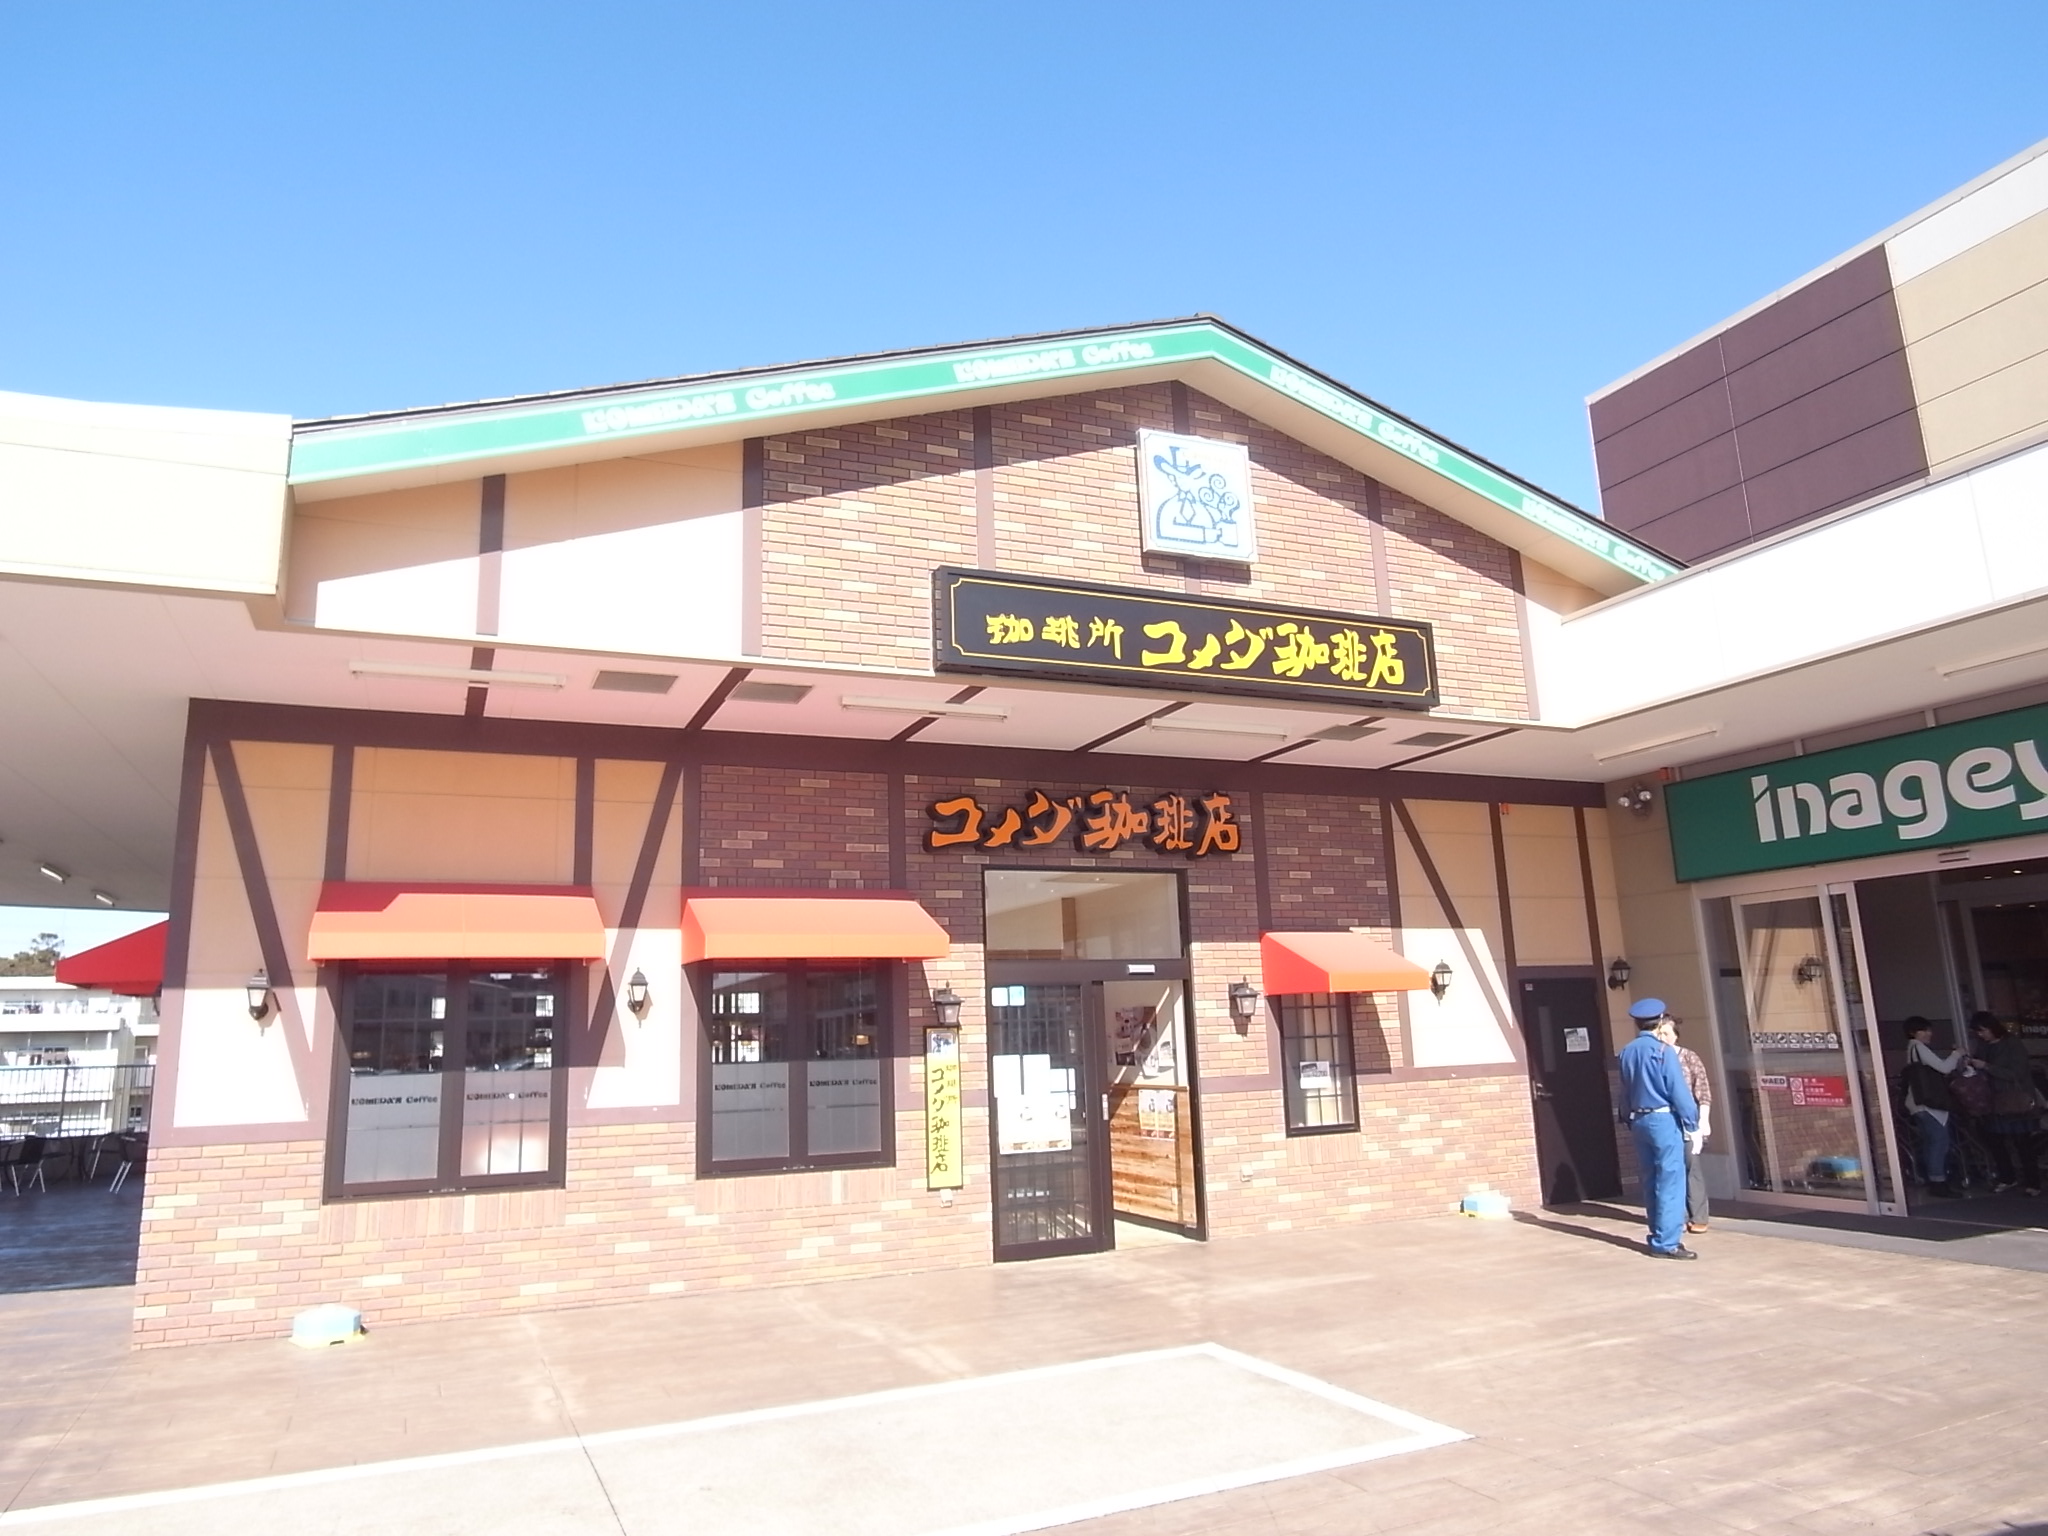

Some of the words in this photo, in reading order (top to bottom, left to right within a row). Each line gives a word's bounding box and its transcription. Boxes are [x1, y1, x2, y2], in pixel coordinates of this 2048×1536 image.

[1082, 341, 1155, 365] Coffee
[746, 381, 836, 410] Coffee
[986, 613, 1125, 660] 珈琲所
[1141, 618, 1405, 688] コメダ珈琲店
[1750, 739, 2048, 843] inagey
[928, 791, 1240, 856] コメダ珈琲店
[2021, 1024, 2048, 1035] inag
[1768, 1077, 1785, 1085] AED
[406, 1095, 438, 1104] Coffee
